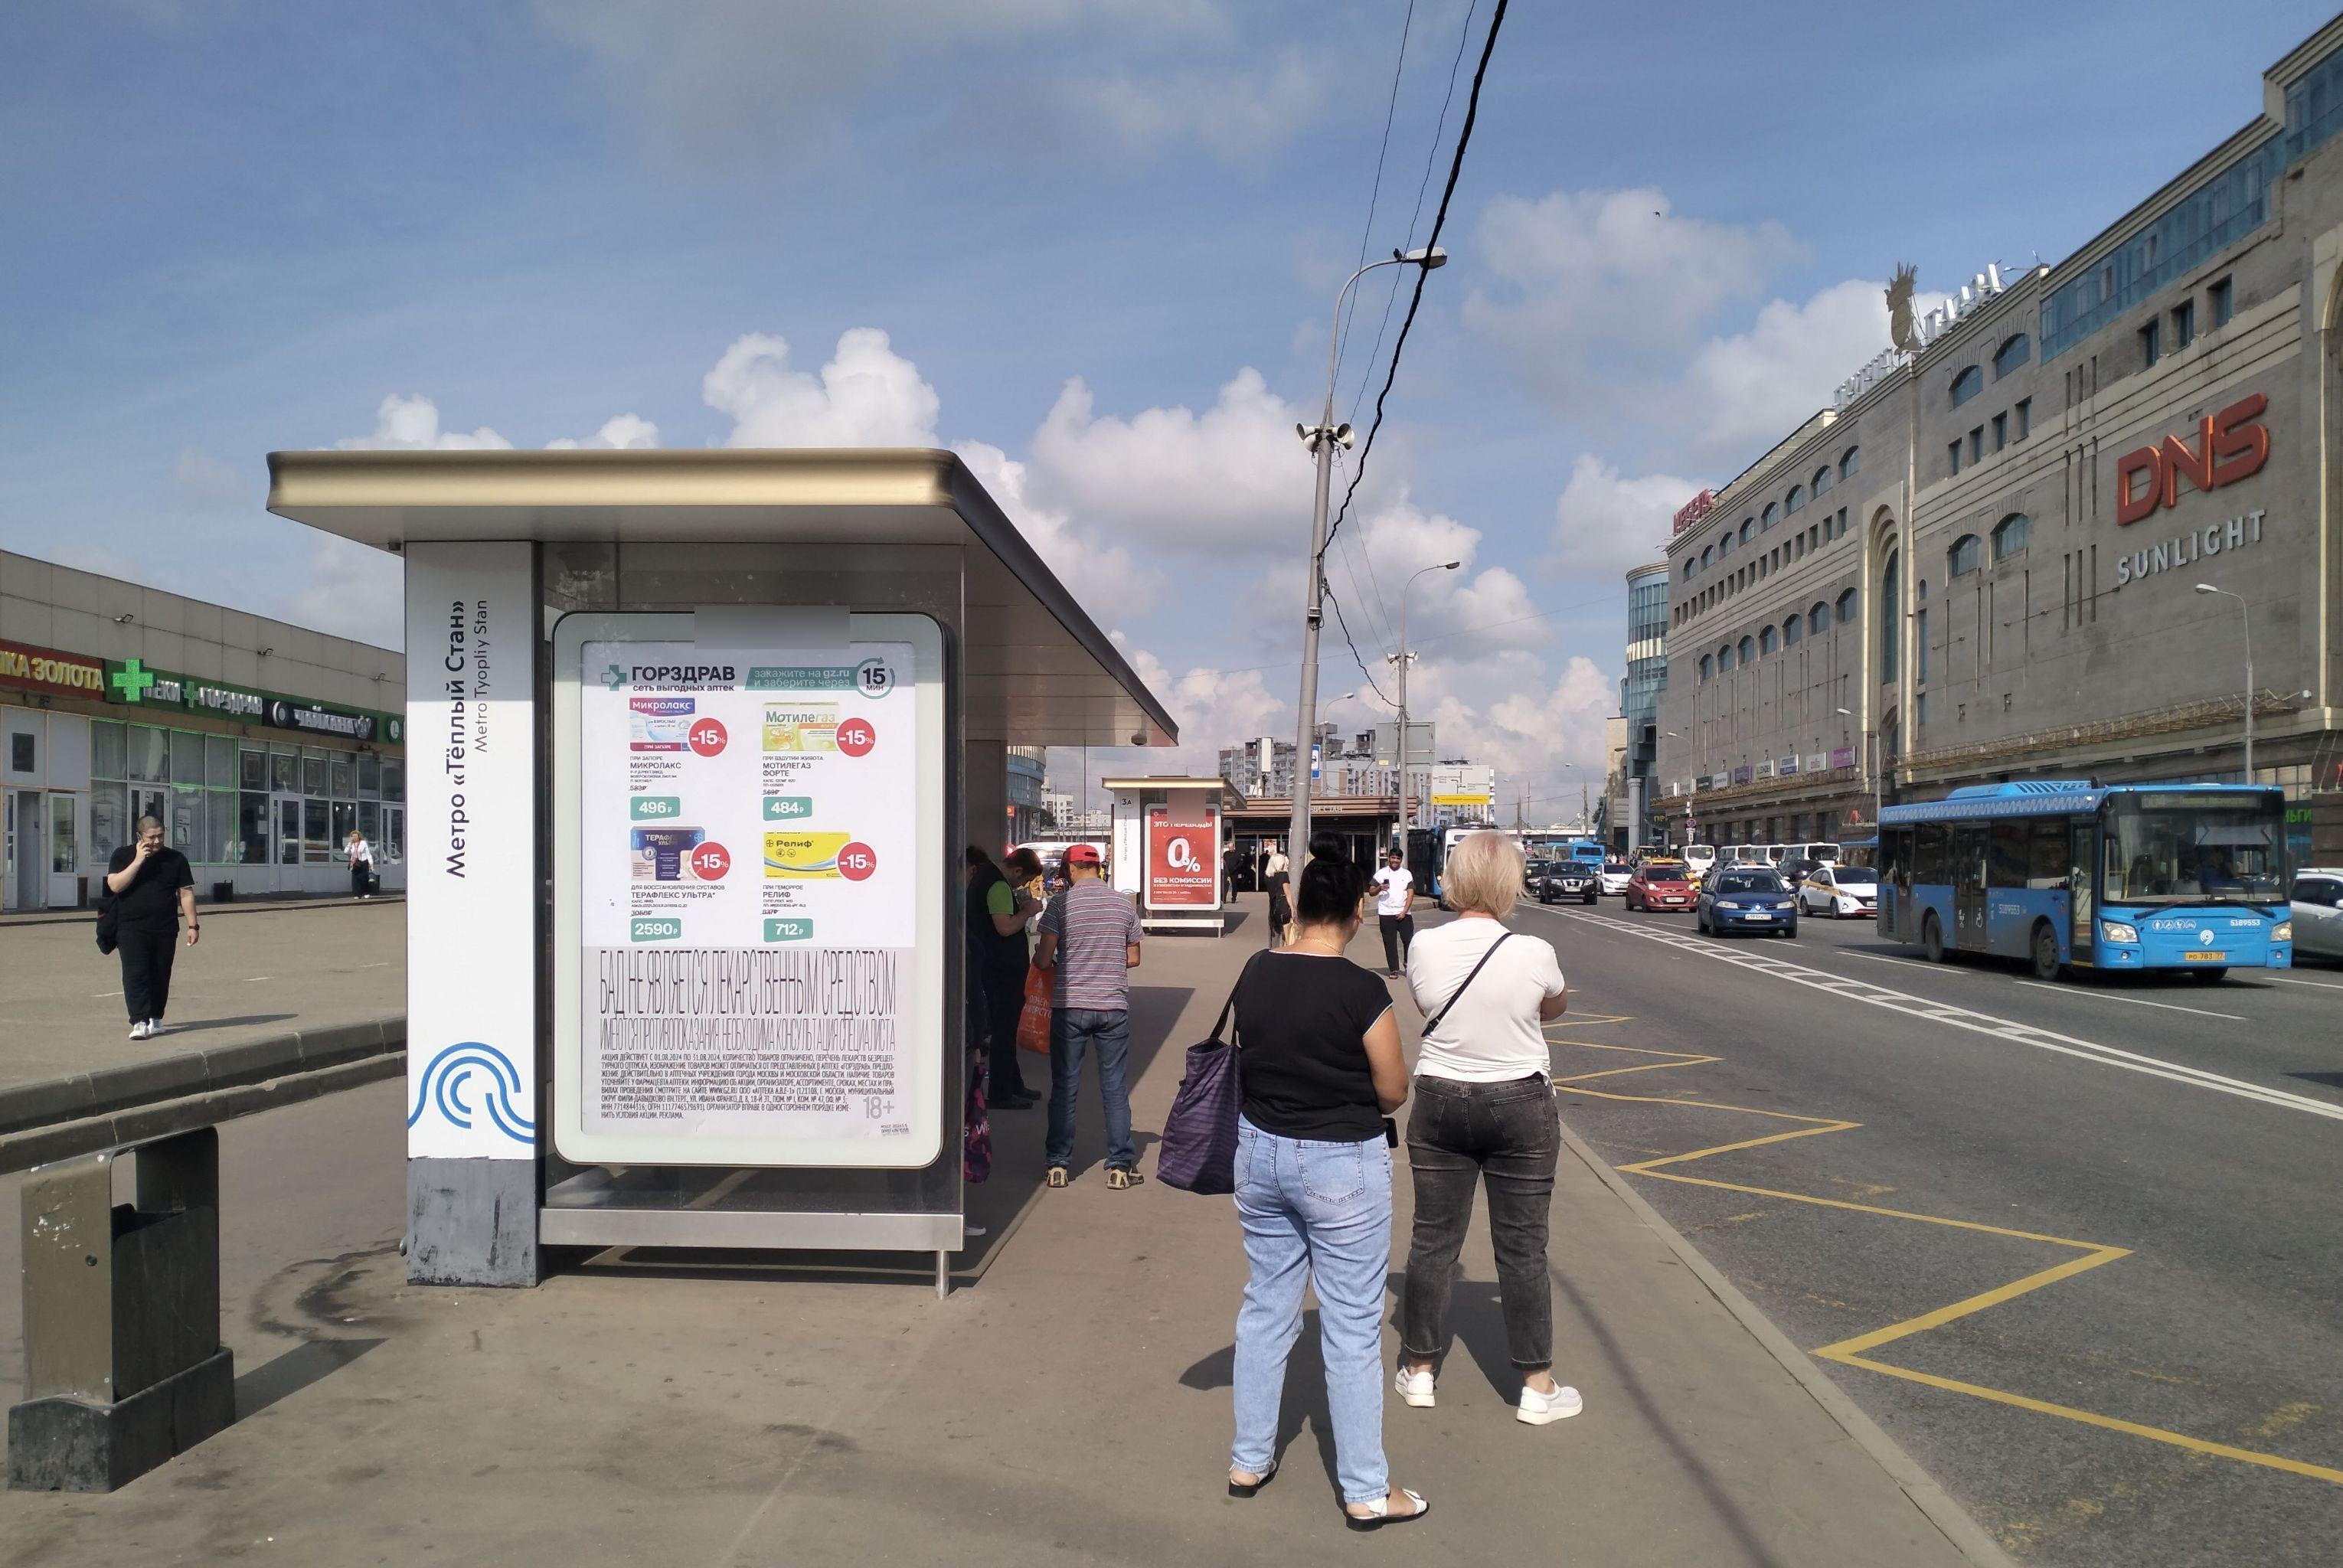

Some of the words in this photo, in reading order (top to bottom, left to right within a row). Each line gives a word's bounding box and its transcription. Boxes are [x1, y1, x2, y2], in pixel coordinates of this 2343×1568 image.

[2117, 392, 2269, 526] DNS
[2118, 508, 2266, 585] SUNLIGHT
[474, 599, 487, 634] Stan
[445, 600, 465, 671] Стан»
[31, 657, 105, 691] ЗОЛОТА
[473, 639, 491, 697] Tyopliy
[632, 666, 735, 684] ГОРЗДРАВ
[754, 669, 806, 678] закажите
[823, 669, 850, 679] gz.ru
[862, 668, 886, 684] 15
[656, 684, 705, 693] выгодных
[764, 678, 815, 688] заберите
[819, 679, 850, 688] через
[198, 686, 263, 715] ГОРЗДРАВ
[632, 701, 691, 712] Микролакс
[474, 703, 487, 753] Metro
[766, 710, 835, 723] Мотилегаз
[446, 680, 465, 786] «Тёплый
[691, 730, 726, 745] -15%
[838, 730, 874, 745] -15%
[446, 794, 469, 878] Метро
[776, 840, 812, 848] Релиф
[693, 854, 729, 869] -15%
[839, 854, 875, 869] -15%
[1167, 838, 1201, 872] 0%
[601, 949, 625, 1019] БАД
[629, 949, 643, 1014] НЕ
[647, 949, 707, 1015] ЯВЛЯЕТСЯ
[711, 949, 819, 1015] ЛЕКАРСТВЕННЫМ
[822, 949, 896, 1019] СРЕДСТВОМ
[863, 1096, 894, 1119] 18+
